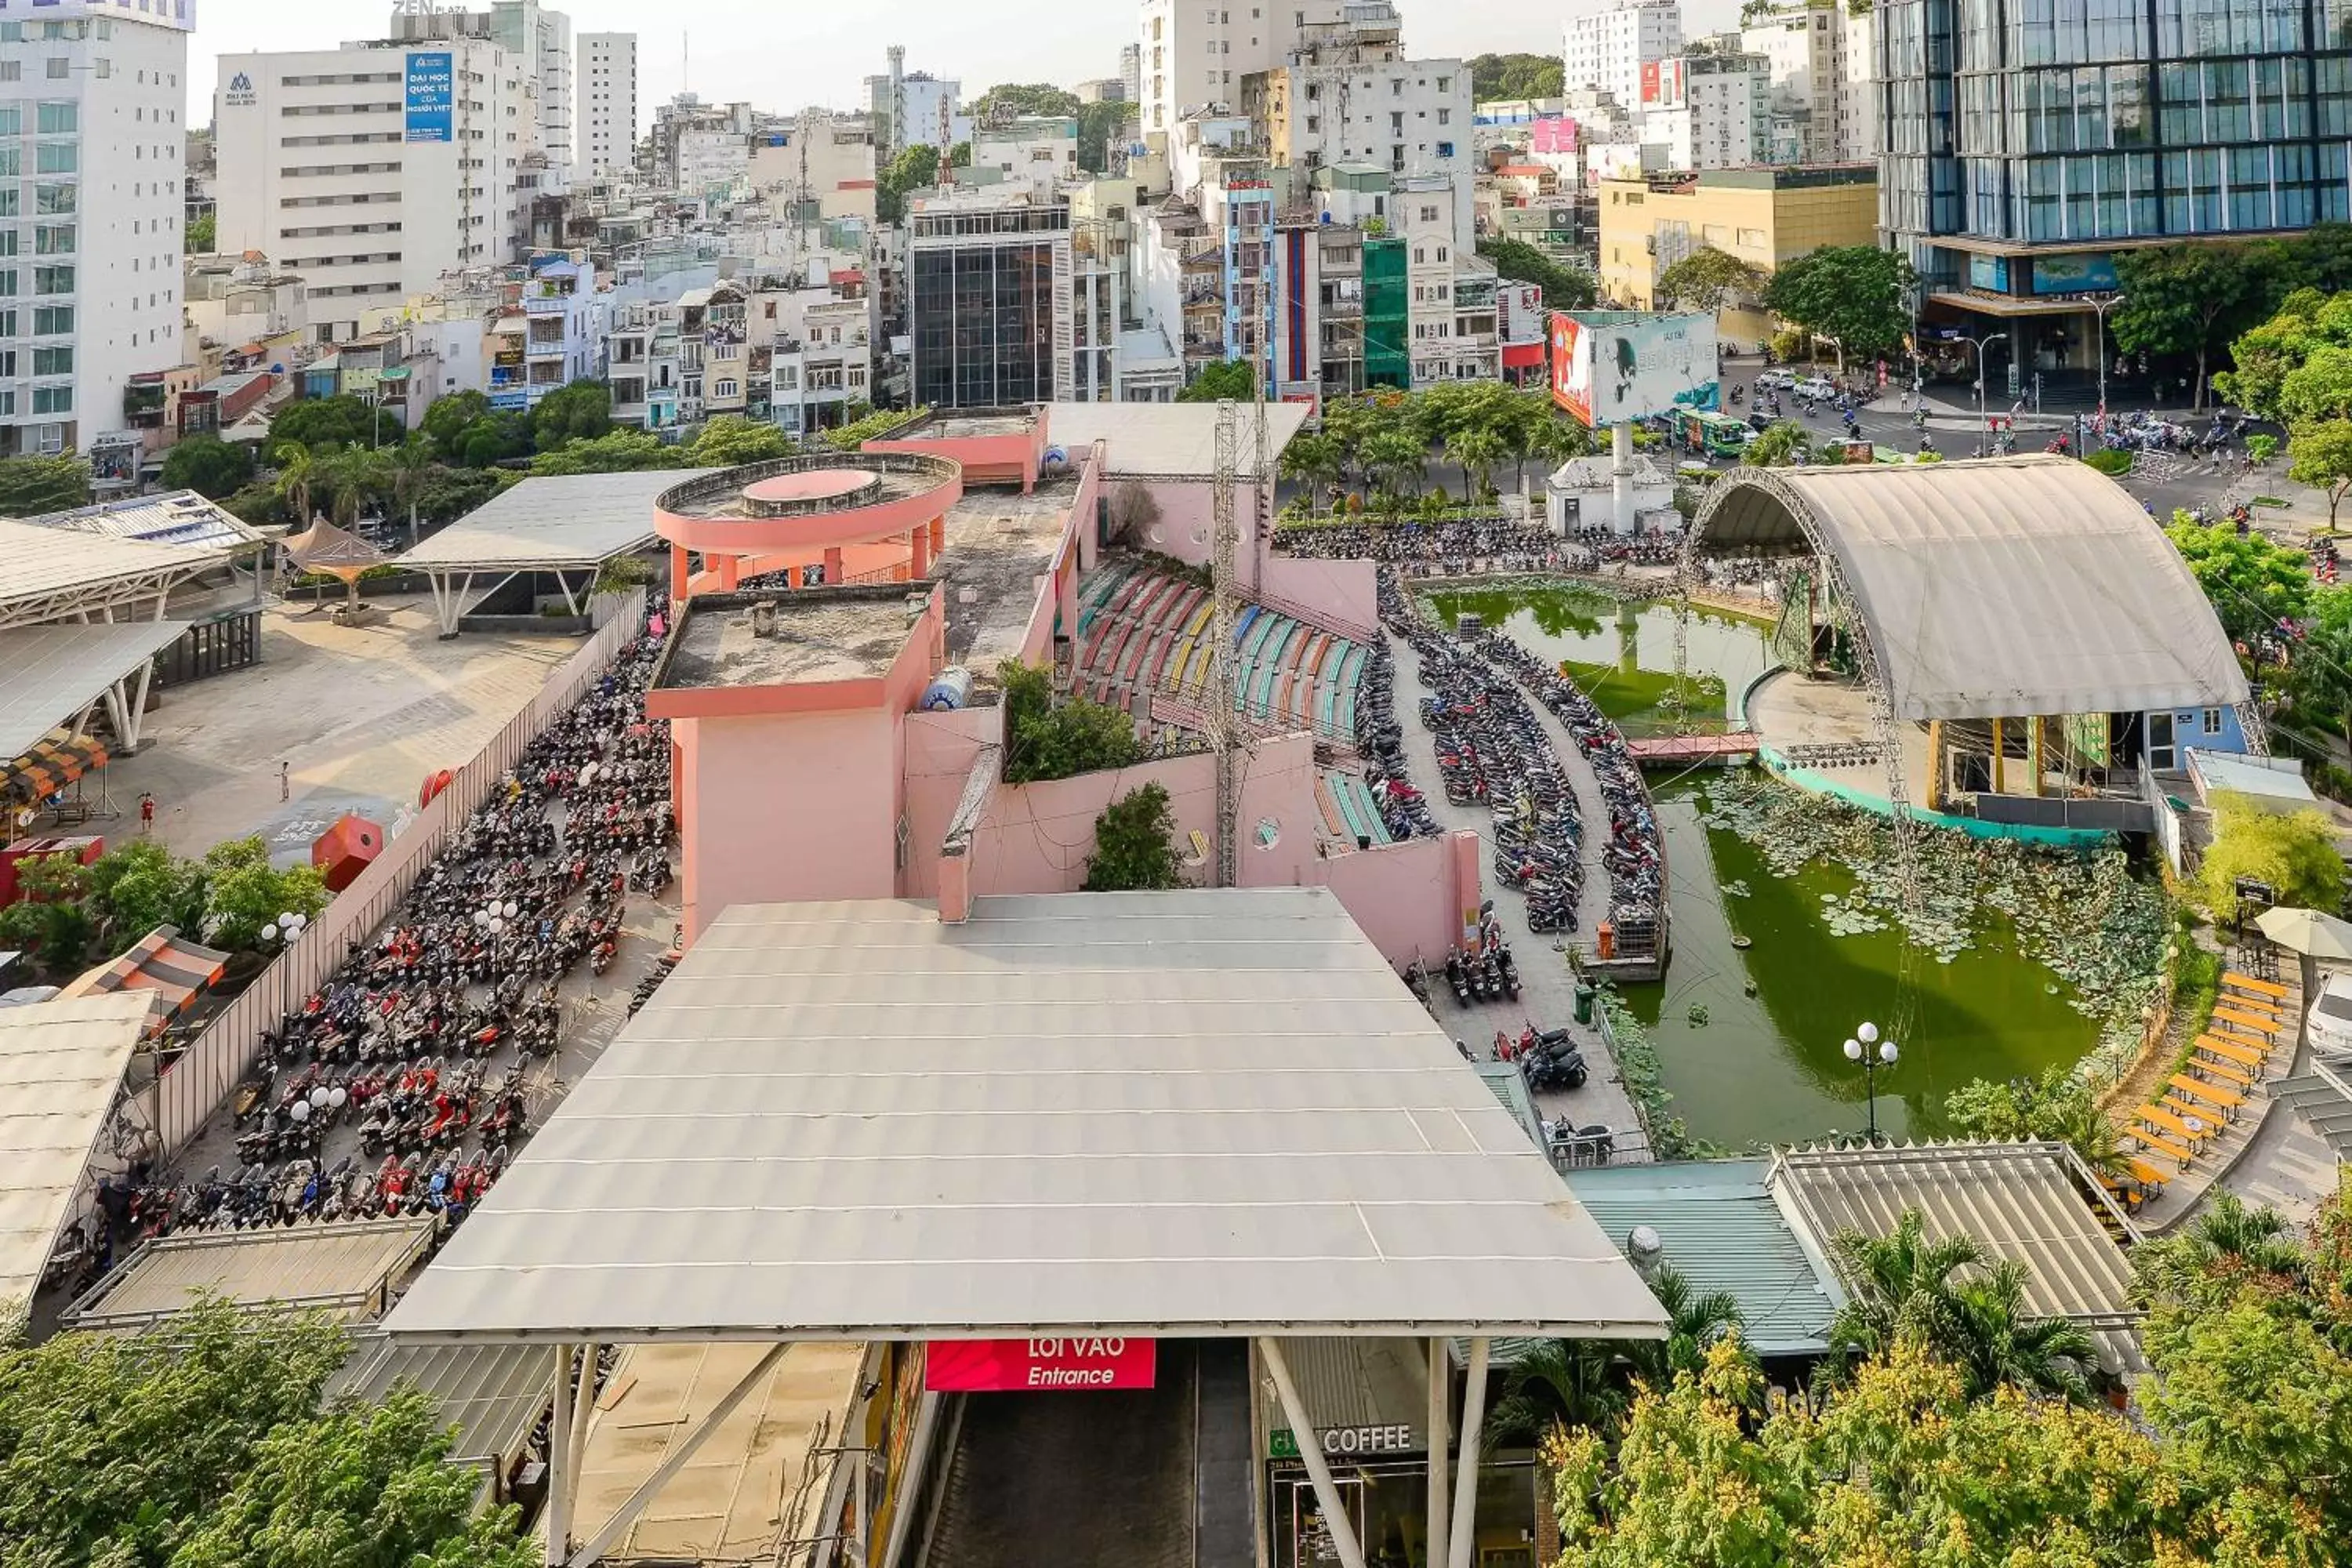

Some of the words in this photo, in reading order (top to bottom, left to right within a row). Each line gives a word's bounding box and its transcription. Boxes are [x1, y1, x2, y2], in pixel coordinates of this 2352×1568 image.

[393, 0, 434, 15] ZEN
[1028, 1367, 1114, 1385] Entrance
[1324, 1425, 1410, 1453] COFFEE
